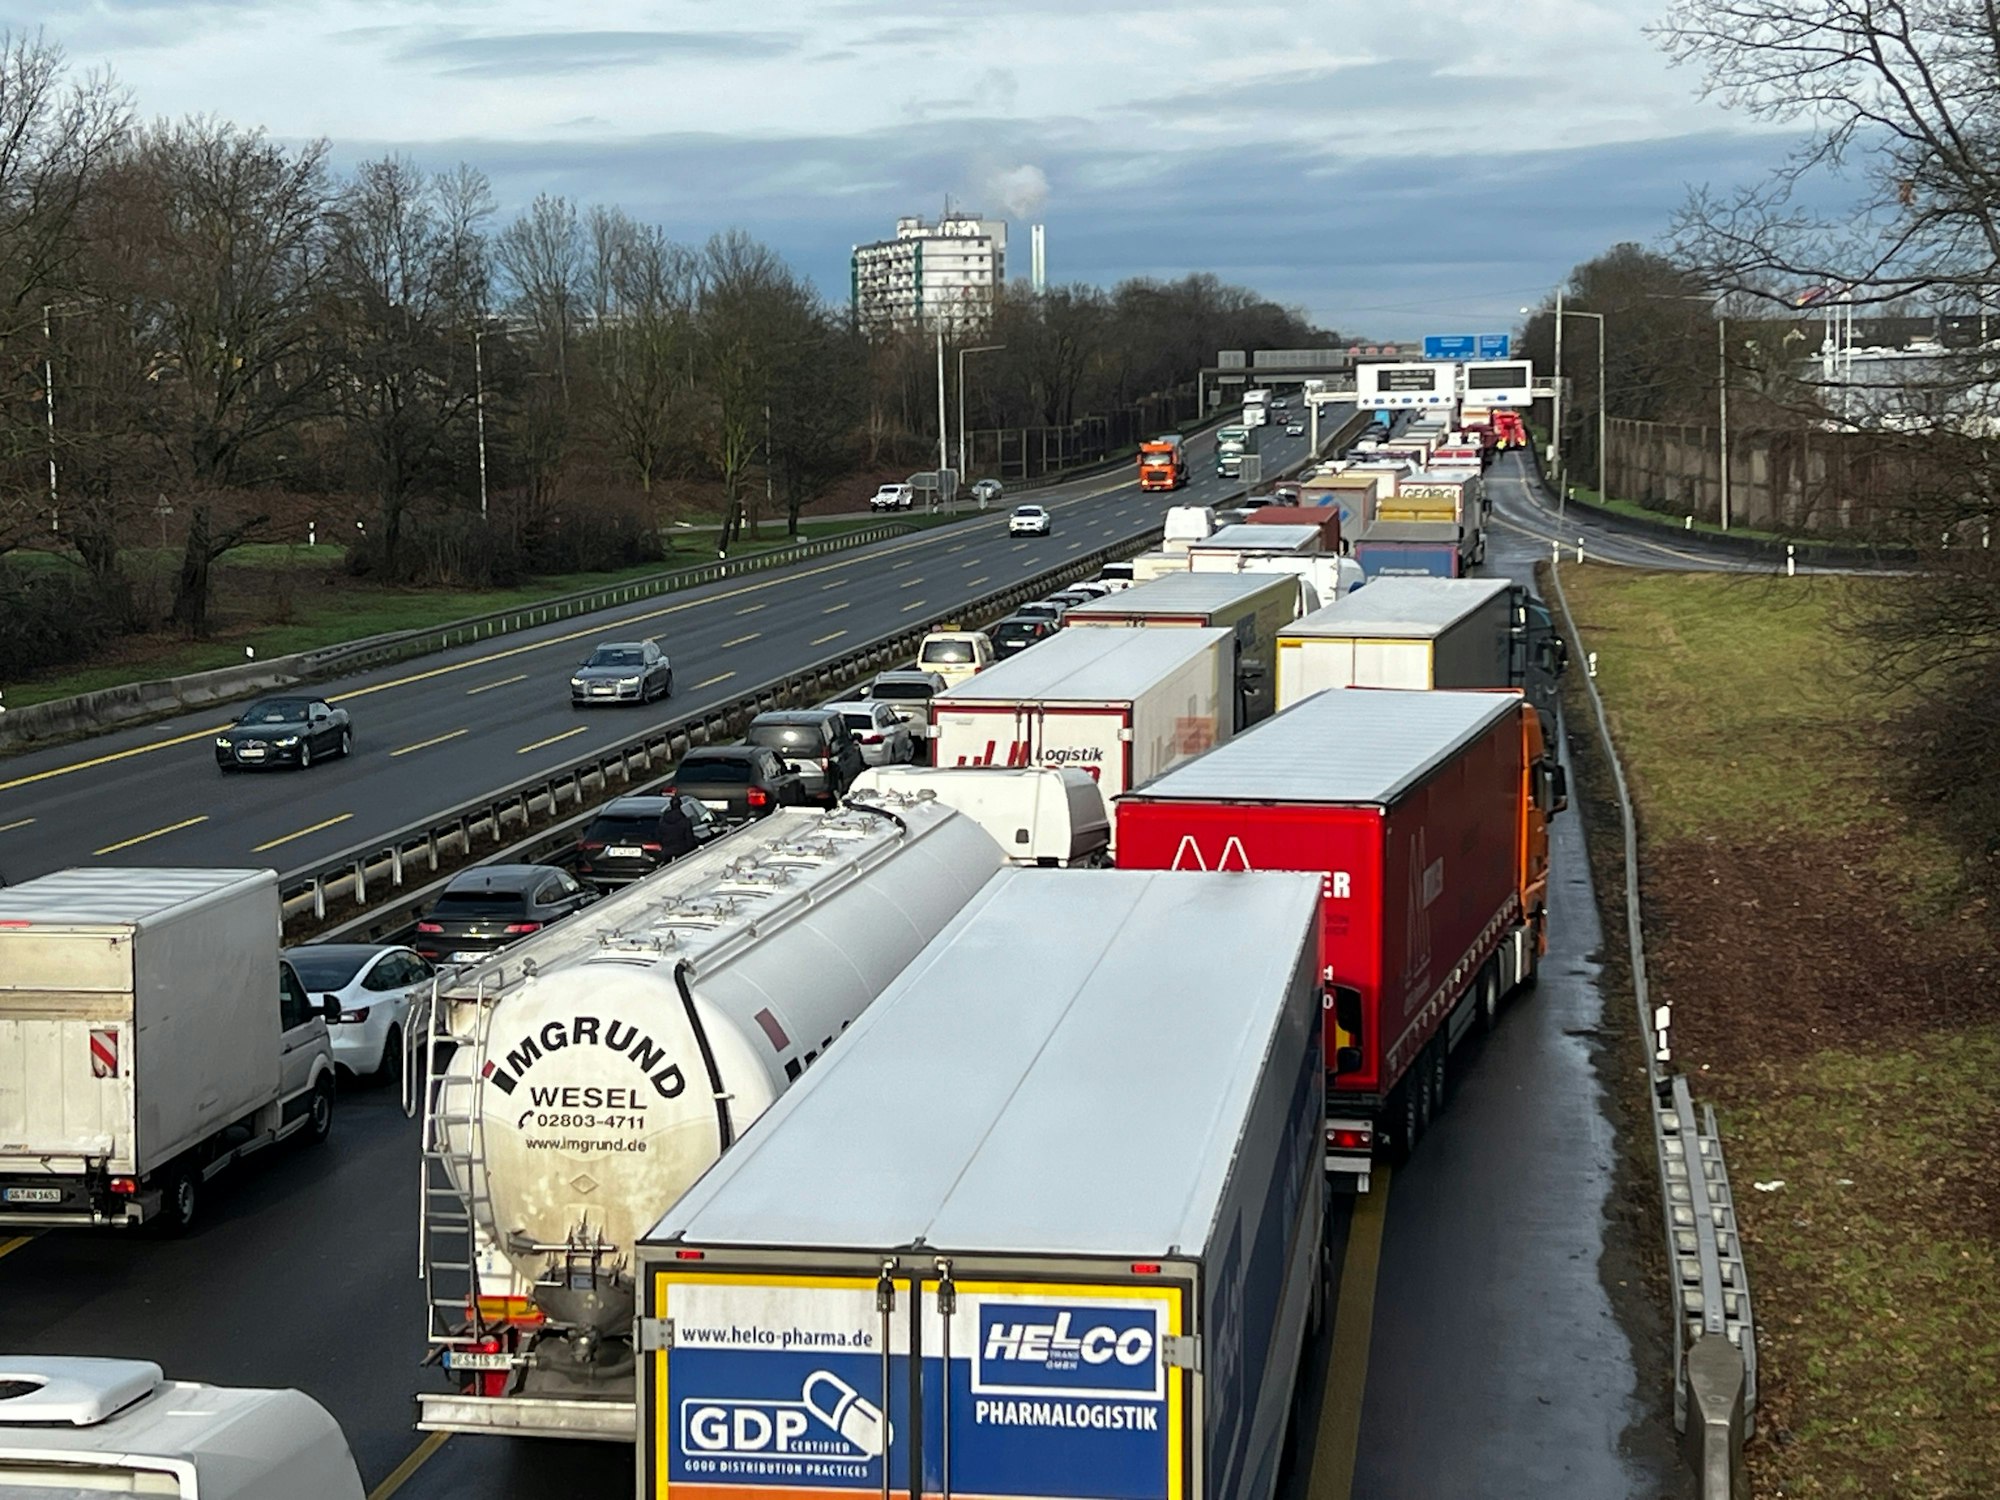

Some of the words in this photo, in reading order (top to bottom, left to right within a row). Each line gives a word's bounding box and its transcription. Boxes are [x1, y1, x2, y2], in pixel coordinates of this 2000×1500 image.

[1036, 746, 1104, 764] Logistik
[530, 1086, 647, 1109] WESEL
[537, 1113, 645, 1129] 02803-4711
[525, 1137, 647, 1153] www.imgrund.de
[682, 1325, 873, 1348] www.helco-pharma.de
[984, 1312, 1153, 1366] HELCO
[976, 1400, 1158, 1431] PHARMALOGISTIK
[690, 1406, 808, 1452] GDP
[790, 1440, 850, 1454] CERTIFIED
[684, 1459, 715, 1472] GOOD
[719, 1460, 802, 1475] DISTRIBUTION
[806, 1464, 868, 1478] PRACTICES
